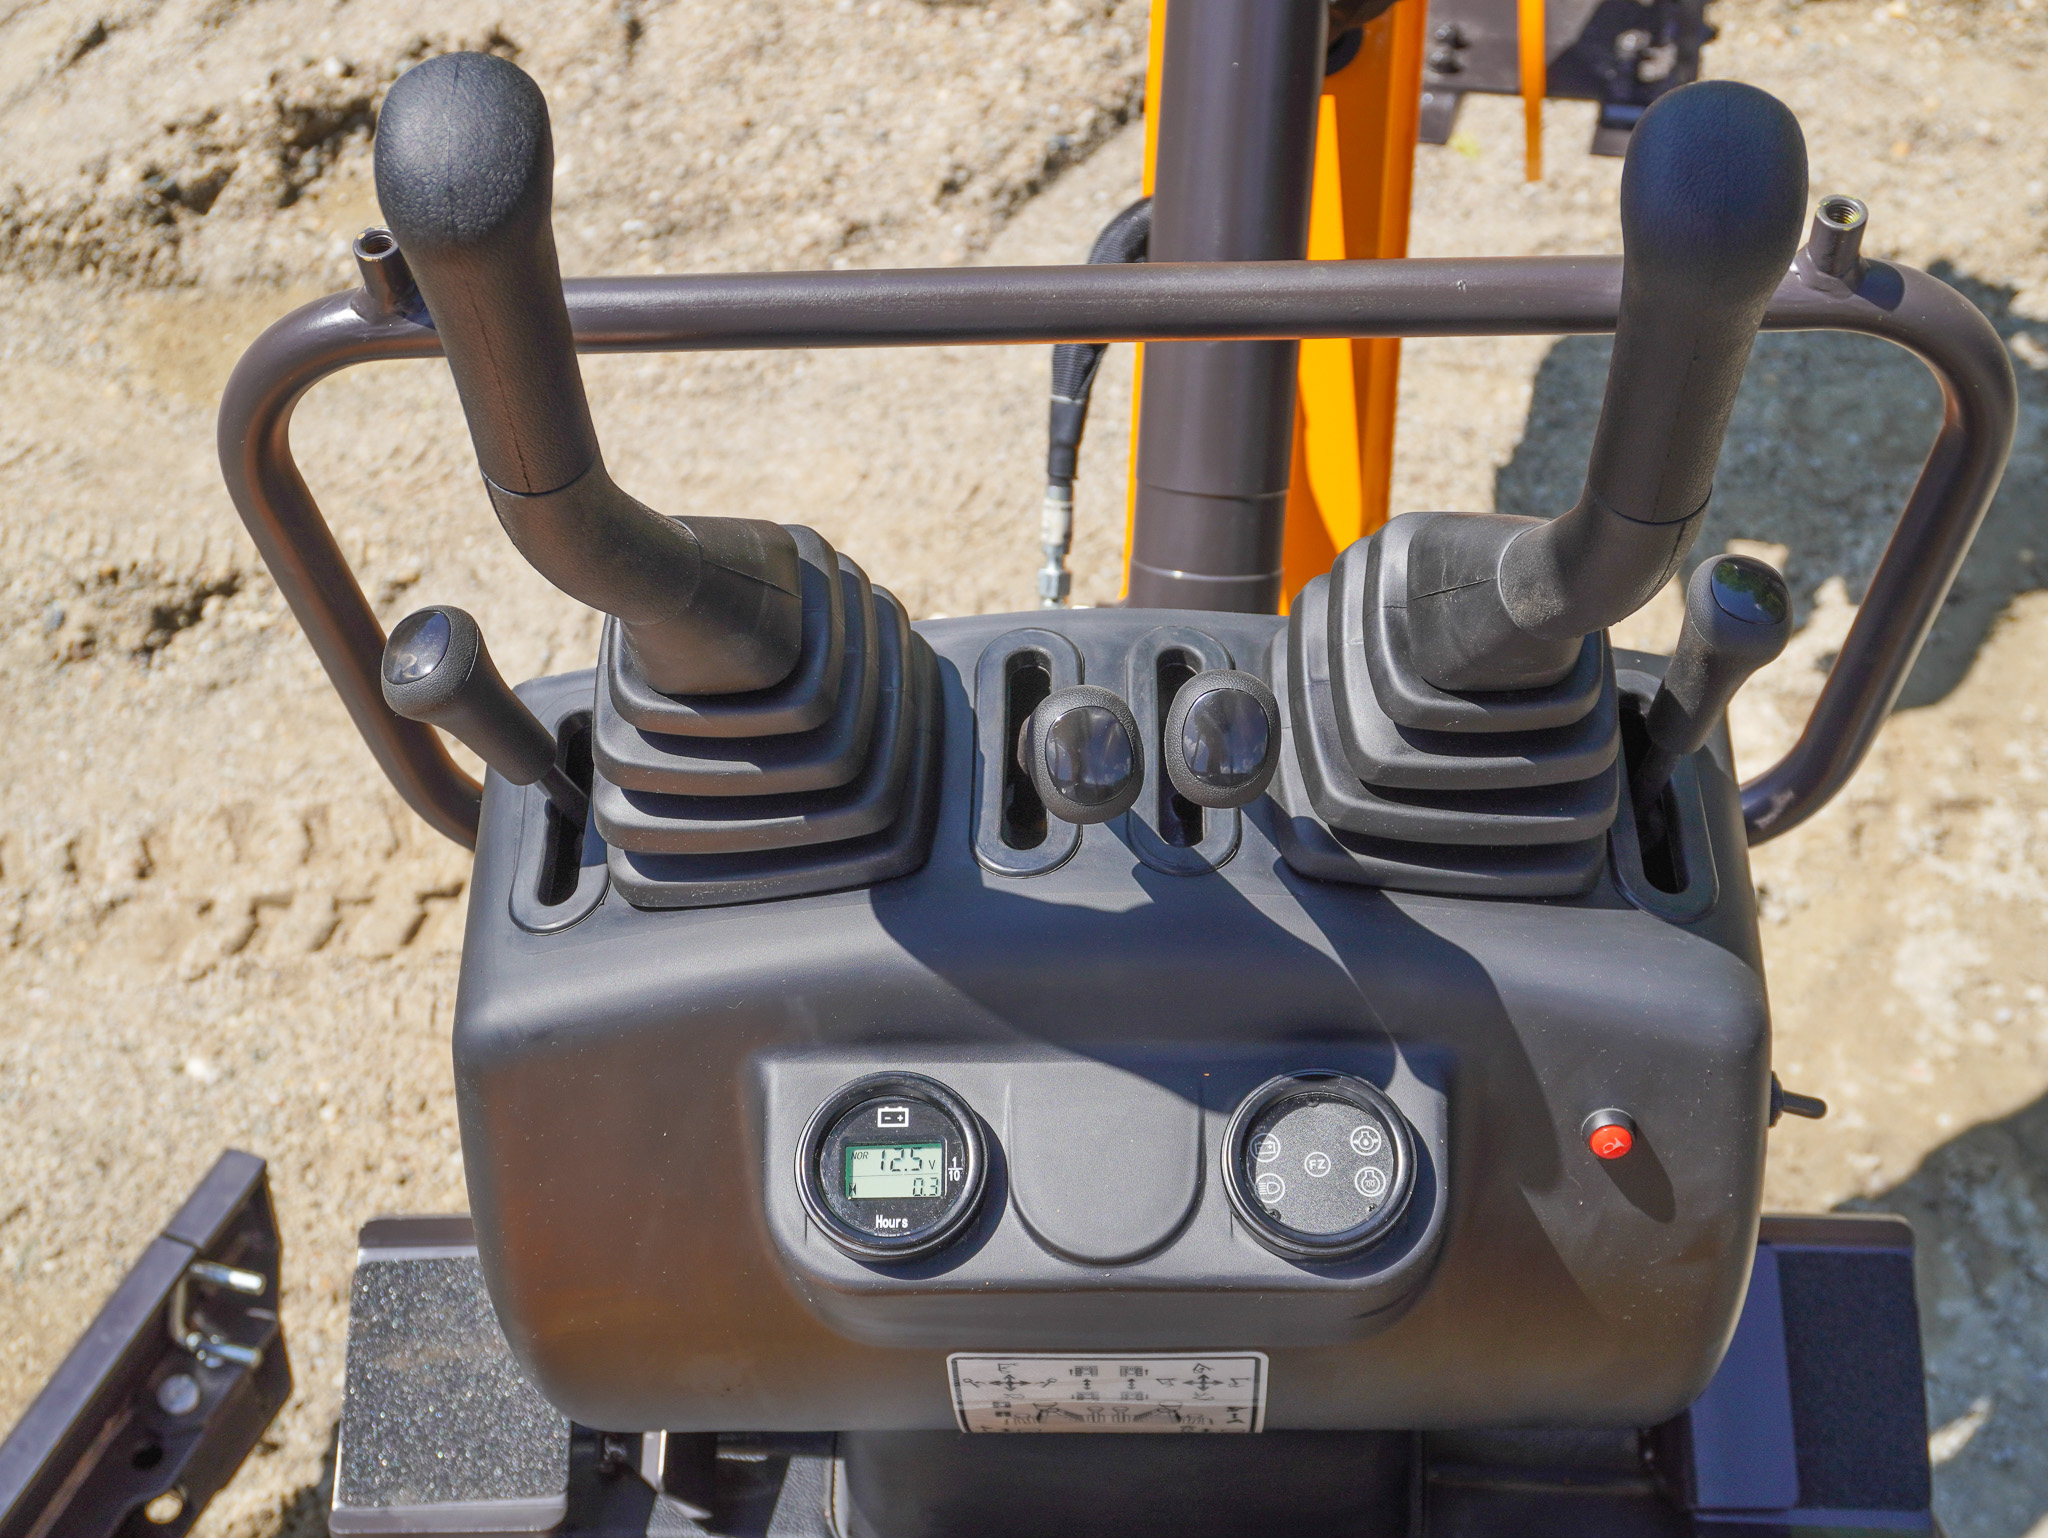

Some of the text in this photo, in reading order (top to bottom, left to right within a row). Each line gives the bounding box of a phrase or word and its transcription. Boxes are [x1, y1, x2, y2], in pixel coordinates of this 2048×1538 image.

[851, 1147, 936, 1172] NOR 12.5 V
[1309, 1160, 1325, 1170] FZ
[912, 1177, 939, 1197] 0.3
[875, 1214, 909, 1229] Hours
